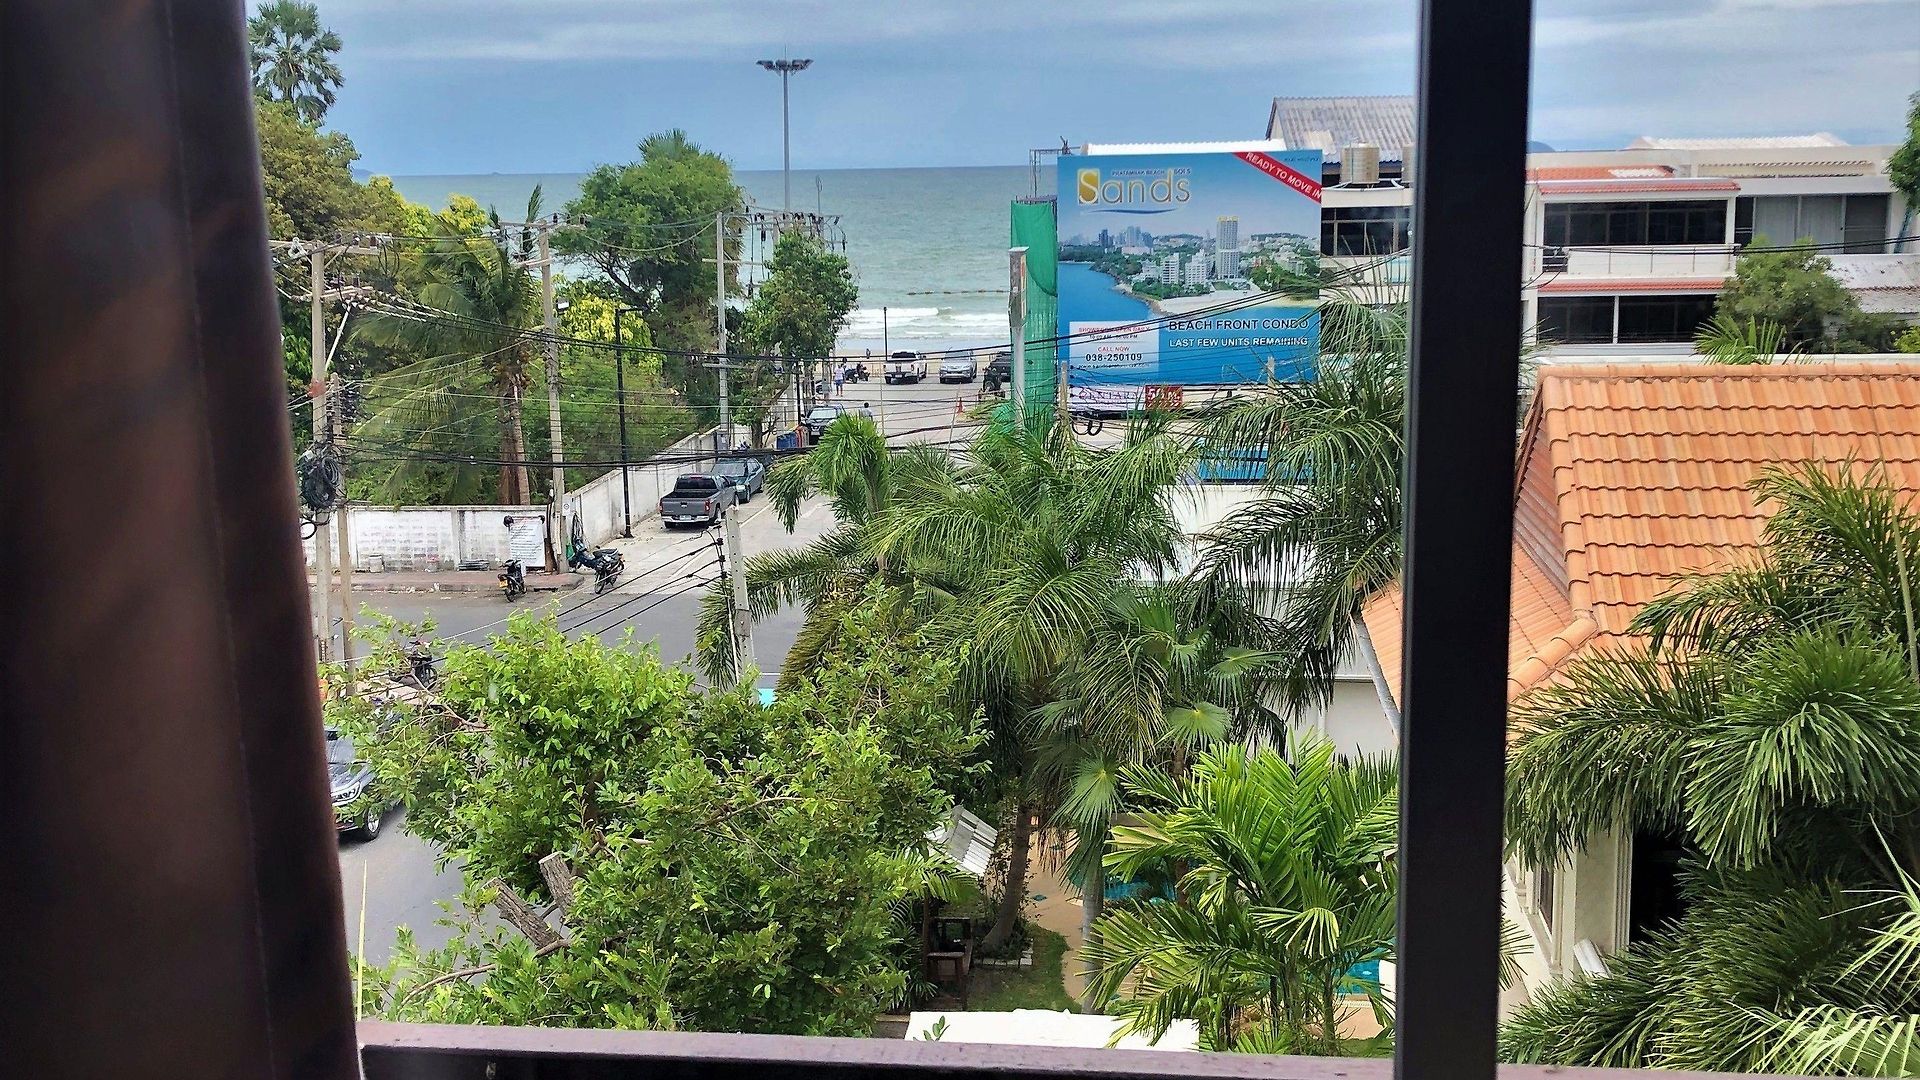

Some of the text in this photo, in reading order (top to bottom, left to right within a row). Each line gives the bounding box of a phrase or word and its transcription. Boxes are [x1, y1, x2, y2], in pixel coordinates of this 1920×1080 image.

[1246, 152, 1321, 199] READY TO MOVE IN
[1079, 168, 1190, 204] Sands
[1169, 319, 1308, 330] BEACH FRONT CONDO
[1169, 337, 1308, 347] LAST FEW UNITS REMAINING
[1085, 353, 1143, 361] 038-250109
